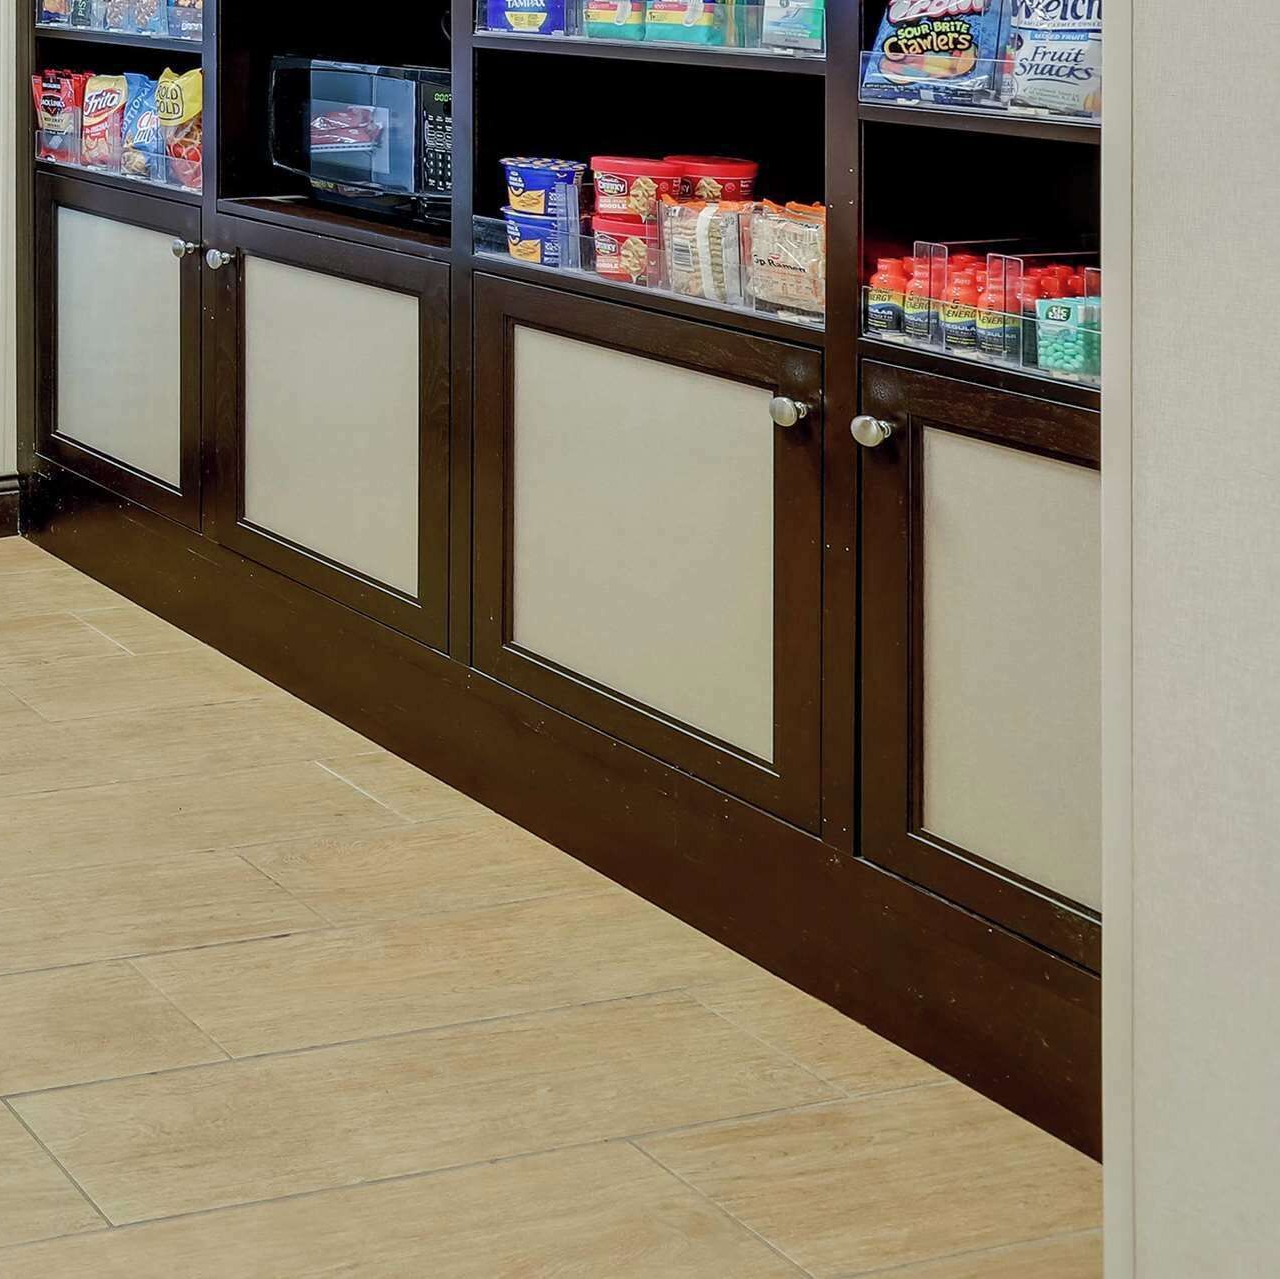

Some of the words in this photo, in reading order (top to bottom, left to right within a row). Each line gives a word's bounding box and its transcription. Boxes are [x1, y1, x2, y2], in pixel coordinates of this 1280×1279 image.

[897, 23, 932, 39] SOUR
[933, 21, 970, 34] BRITE
[1059, 33, 1086, 41] FRUIT
[884, 34, 973, 61] Crawlers
[1030, 45, 1085, 63] Fruit
[1015, 58, 1094, 81] Snacks
[768, 259, 807, 273] Ramen
[869, 294, 891, 302] NERGY
[946, 309, 977, 318] ENERG
[1052, 306, 1068, 315] tic
[1048, 313, 1067, 321] tac
[943, 322, 977, 331] REGULA
